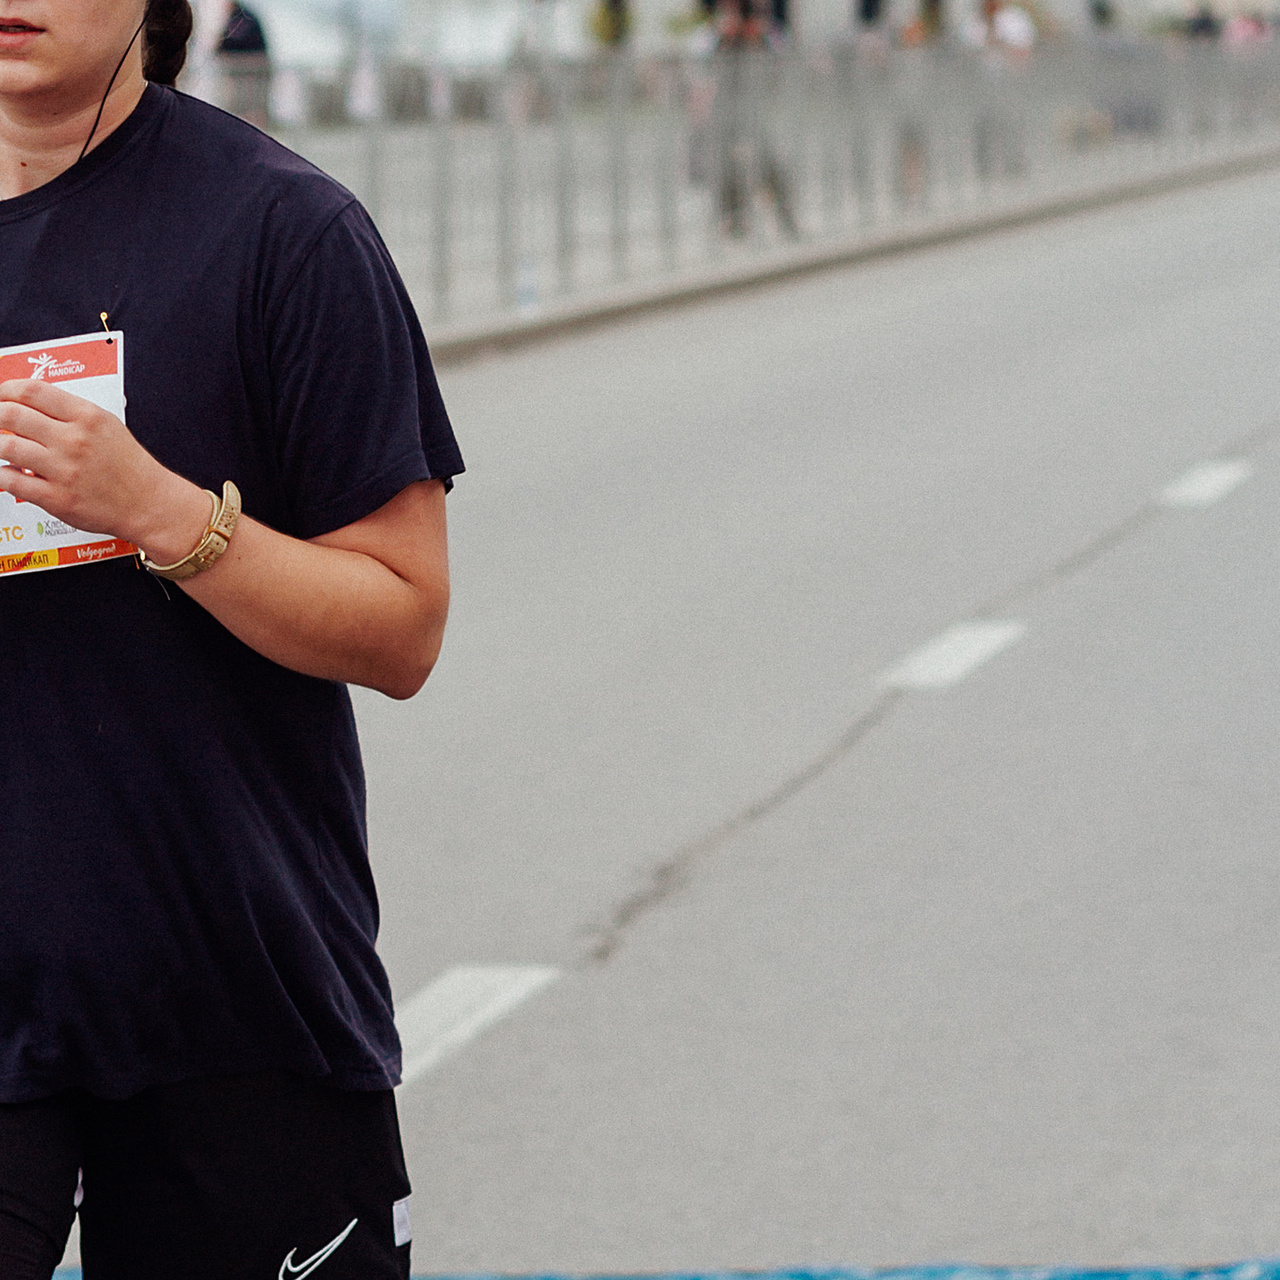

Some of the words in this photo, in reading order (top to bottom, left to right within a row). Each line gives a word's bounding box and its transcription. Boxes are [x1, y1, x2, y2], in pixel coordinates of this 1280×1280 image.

[48, 364, 86, 378] HANDICAP
[77, 543, 116, 559] Volgograd
[7, 554, 49, 570] ГАНДИКАП
